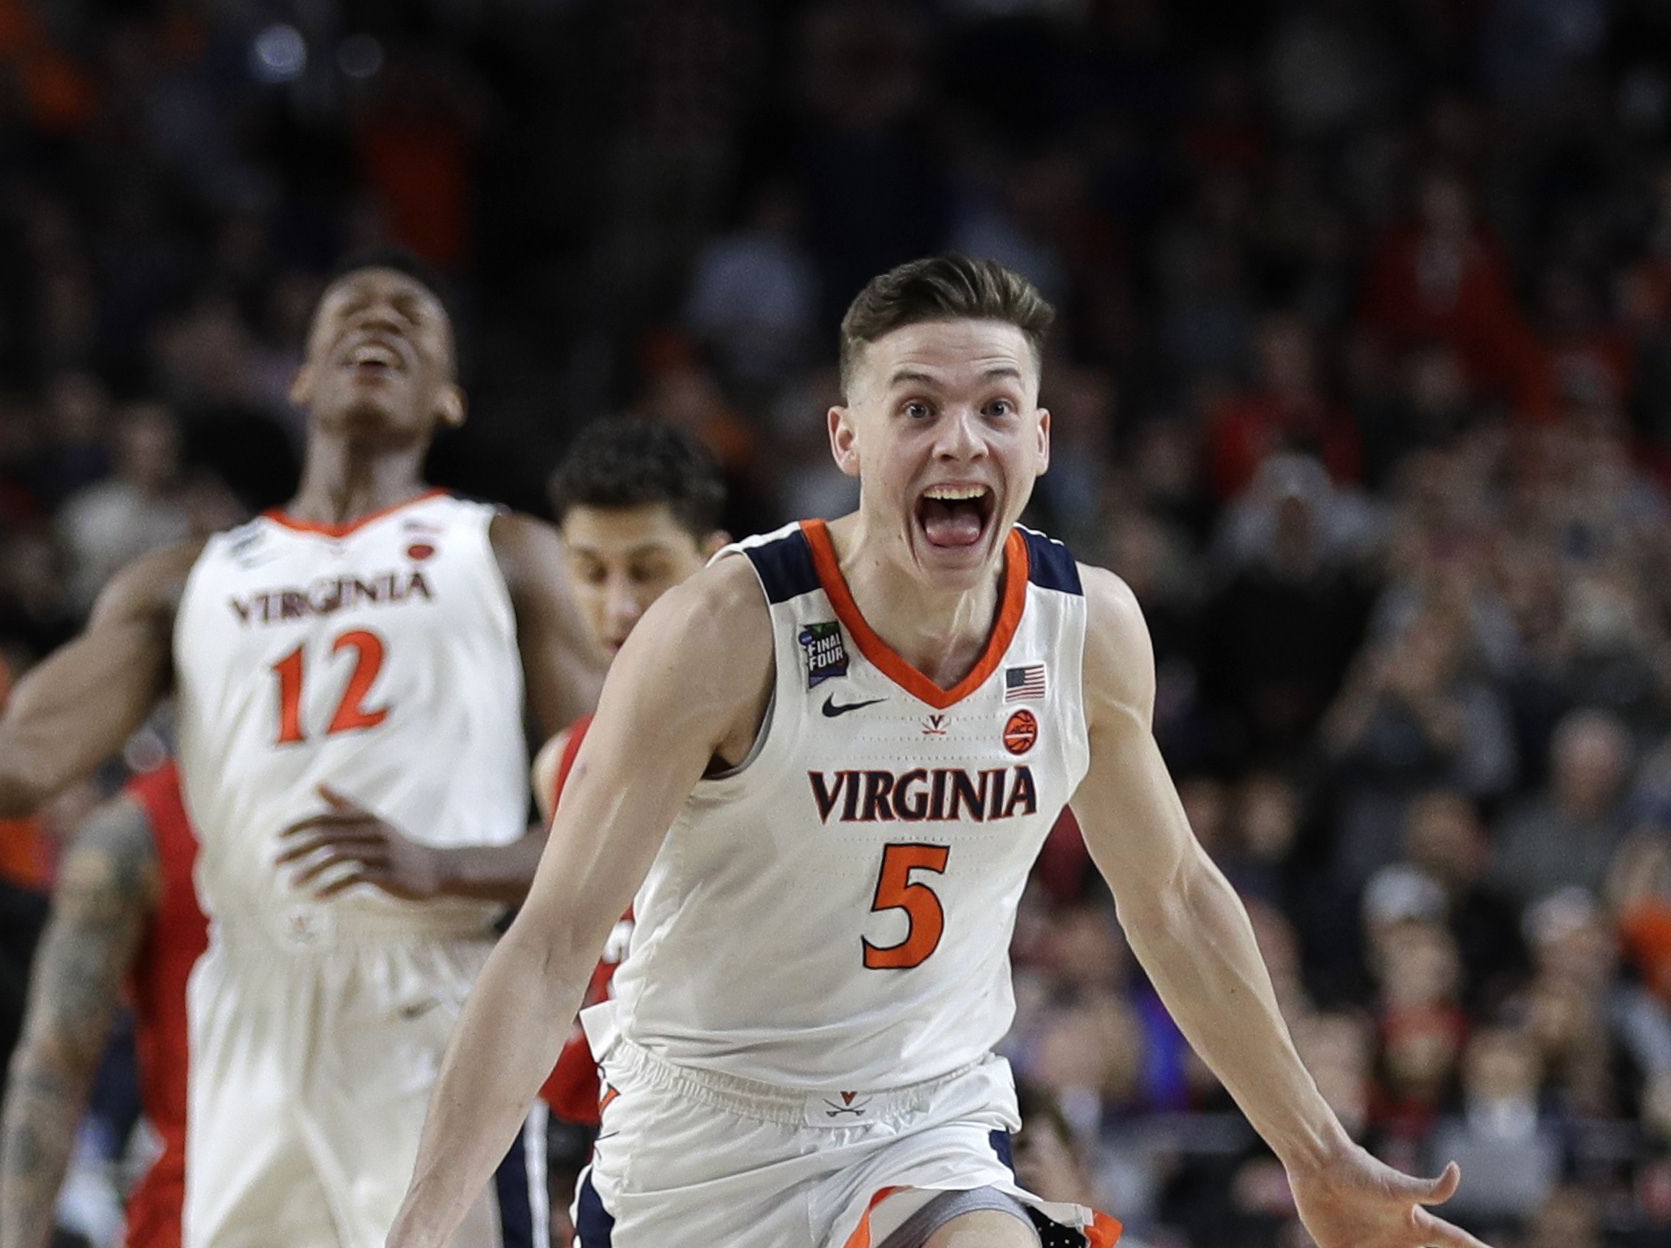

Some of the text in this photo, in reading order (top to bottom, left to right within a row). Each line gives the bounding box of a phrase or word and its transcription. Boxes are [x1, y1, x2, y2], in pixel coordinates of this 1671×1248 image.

[229, 571, 434, 624] VIRGINIA
[808, 633, 841, 657] FINAL
[809, 646, 844, 671] FOUR
[271, 630, 394, 746] 12
[808, 765, 1037, 825] VIRGINIA
[861, 843, 950, 970] 5
